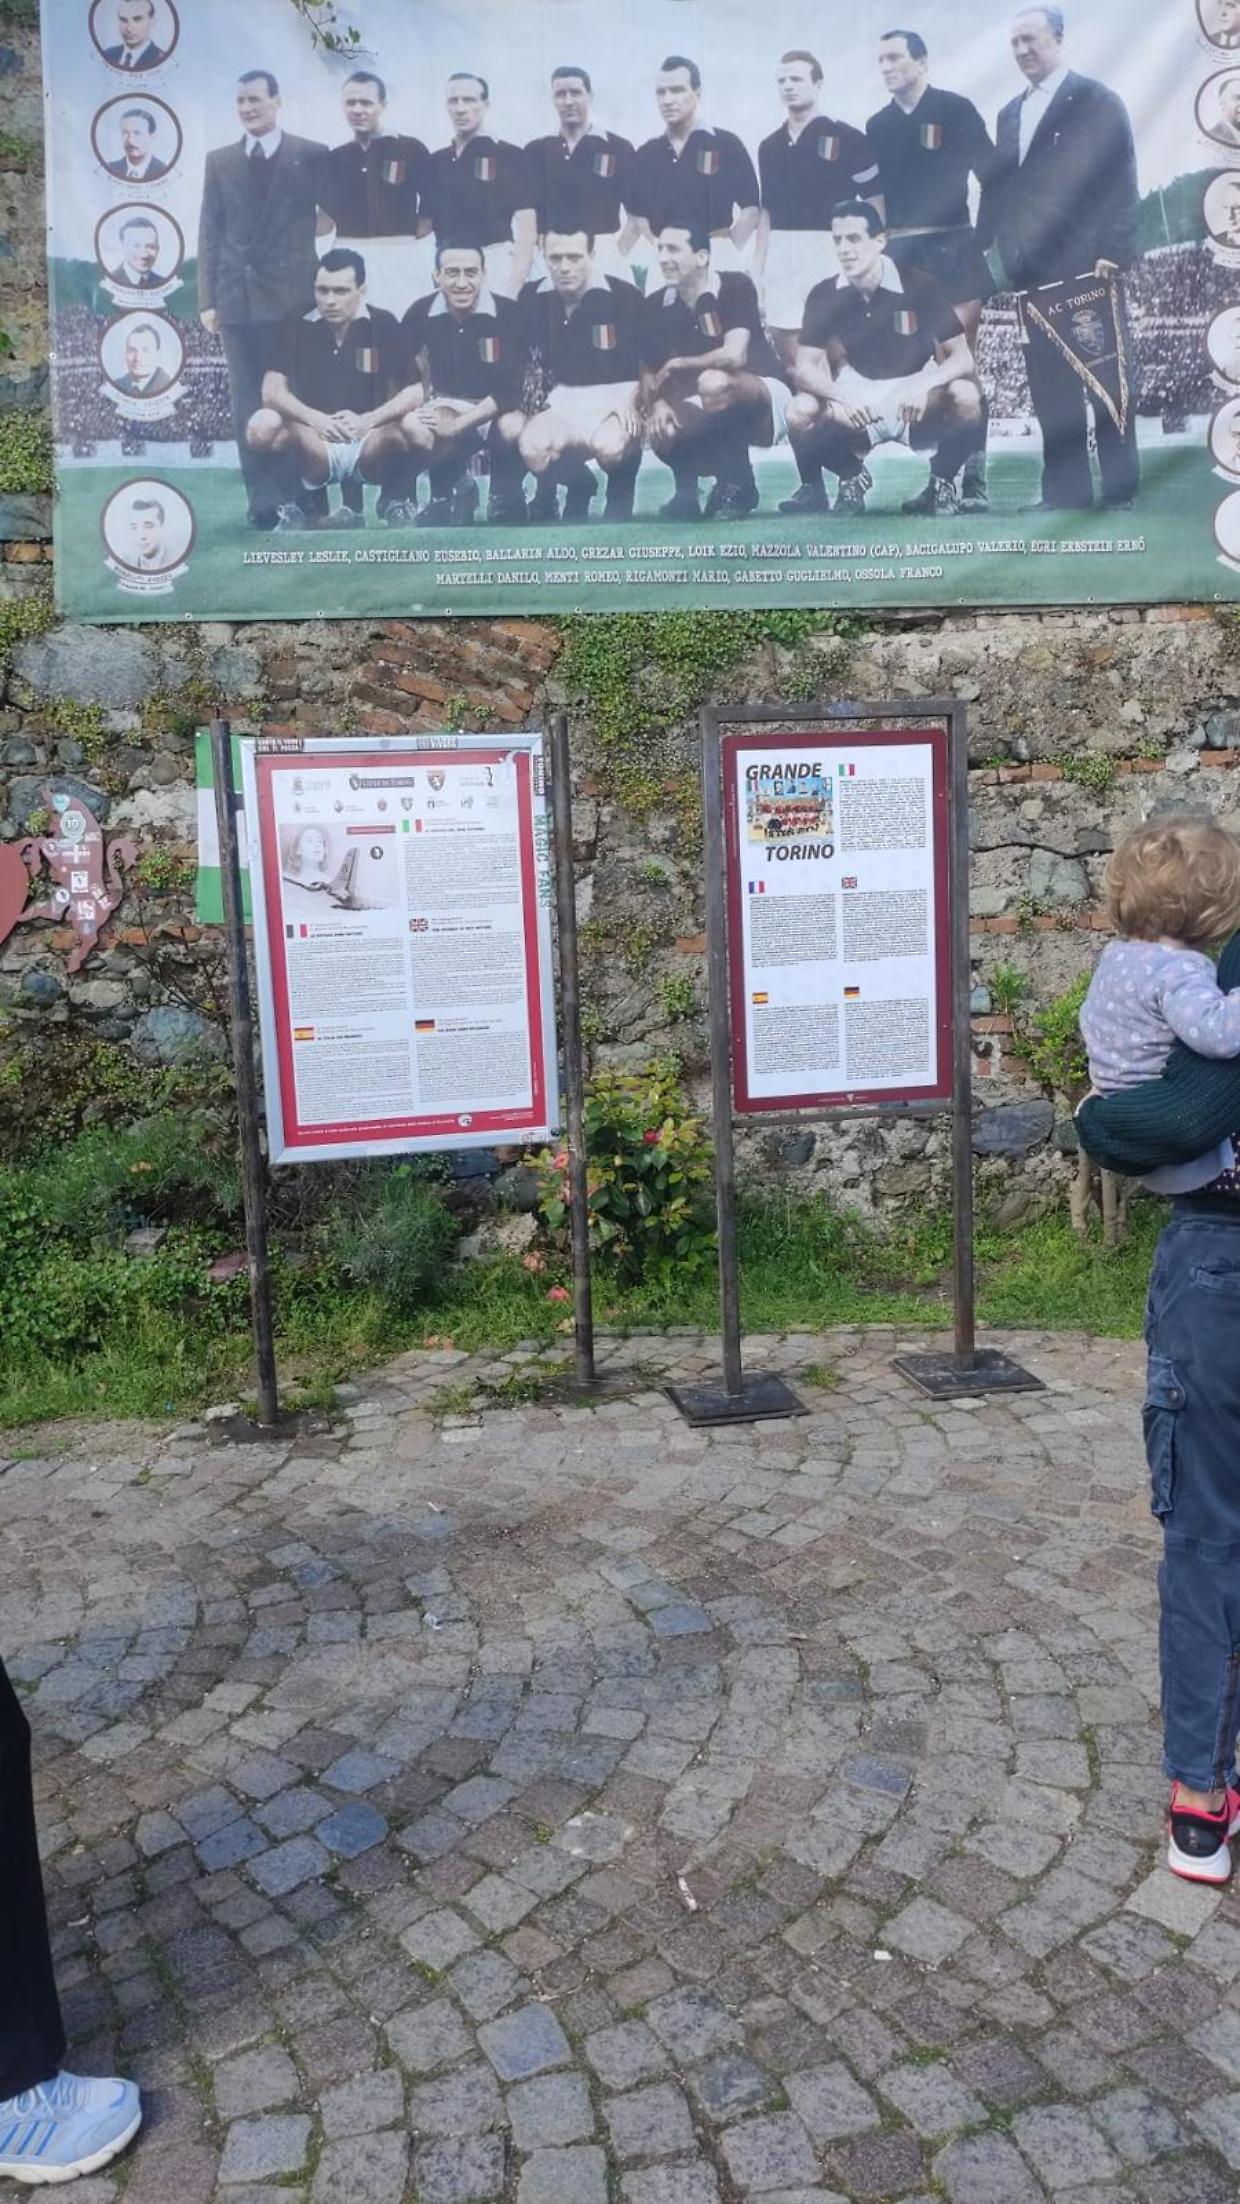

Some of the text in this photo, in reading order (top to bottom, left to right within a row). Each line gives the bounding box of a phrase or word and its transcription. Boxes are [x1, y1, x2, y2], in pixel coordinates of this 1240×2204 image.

[1048, 287, 1106, 316] AC TORINO
[243, 551, 304, 564] LIEVESLEY
[355, 550, 430, 563] CASTIGLIANO
[486, 549, 543, 561] BALLARIN
[547, 548, 579, 561] ALDO,
[581, 547, 625, 560] GREZAR
[629, 546, 685, 559] GIUSEPPE,
[689, 545, 715, 557] LOIK
[720, 545, 748, 559] EZIO,
[752, 545, 801, 558] MAZZOLA
[806, 544, 866, 557] VALENTINO
[906, 543, 974, 556] BACIGALUPO
[978, 541, 1027, 555] VALERIO,
[1031, 540, 1057, 552] EGRI
[1061, 540, 1113, 552] ERBSTEIN
[436, 573, 494, 585] MARTELLI
[498, 572, 541, 585] DANILO,
[545, 571, 579, 583] MENTI
[584, 571, 621, 584] ROMEO,
[626, 570, 688, 583] RIGAMONTI
[693, 570, 731, 584] MARIO,
[786, 569, 851, 583] GUGLIELMO,
[855, 568, 895, 580] OSSOLA
[900, 567, 943, 579] FRANCO
[746, 763, 822, 780] GRANDE
[533, 813, 551, 910] MAGIC FANS
[766, 844, 835, 862] TORINO
